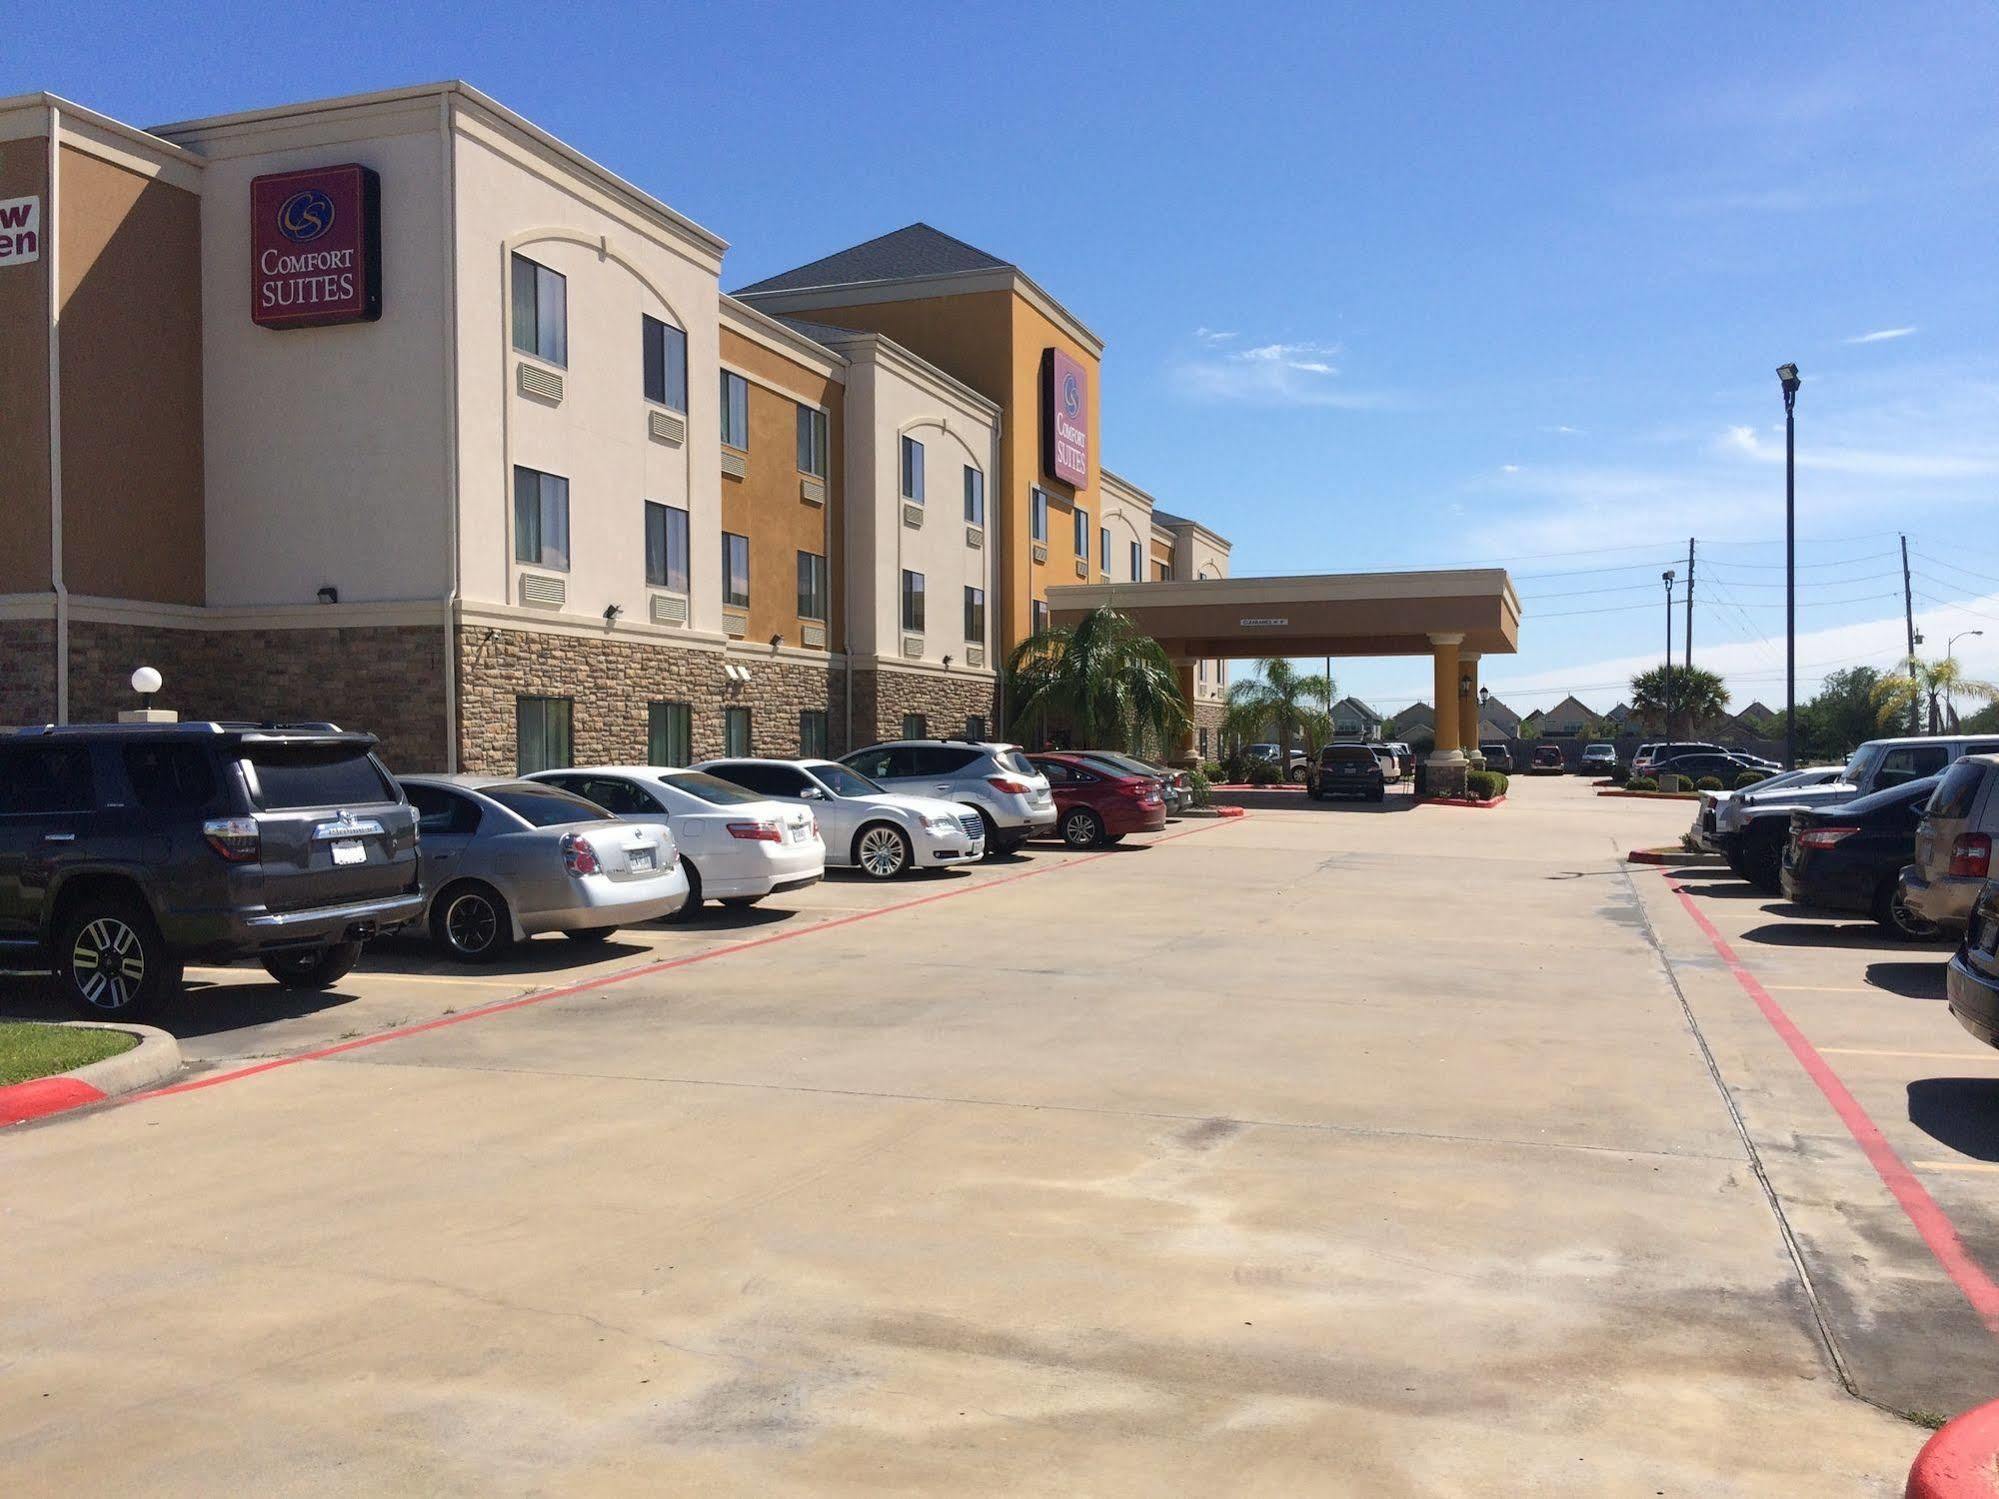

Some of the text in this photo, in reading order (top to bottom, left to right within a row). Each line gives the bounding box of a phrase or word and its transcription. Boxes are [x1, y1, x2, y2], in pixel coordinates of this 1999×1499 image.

[261, 249, 354, 276] COMFORT
[262, 273, 354, 308] SUITES
[1057, 412, 1085, 448] COMFORT
[1057, 440, 1086, 475] SUITES
